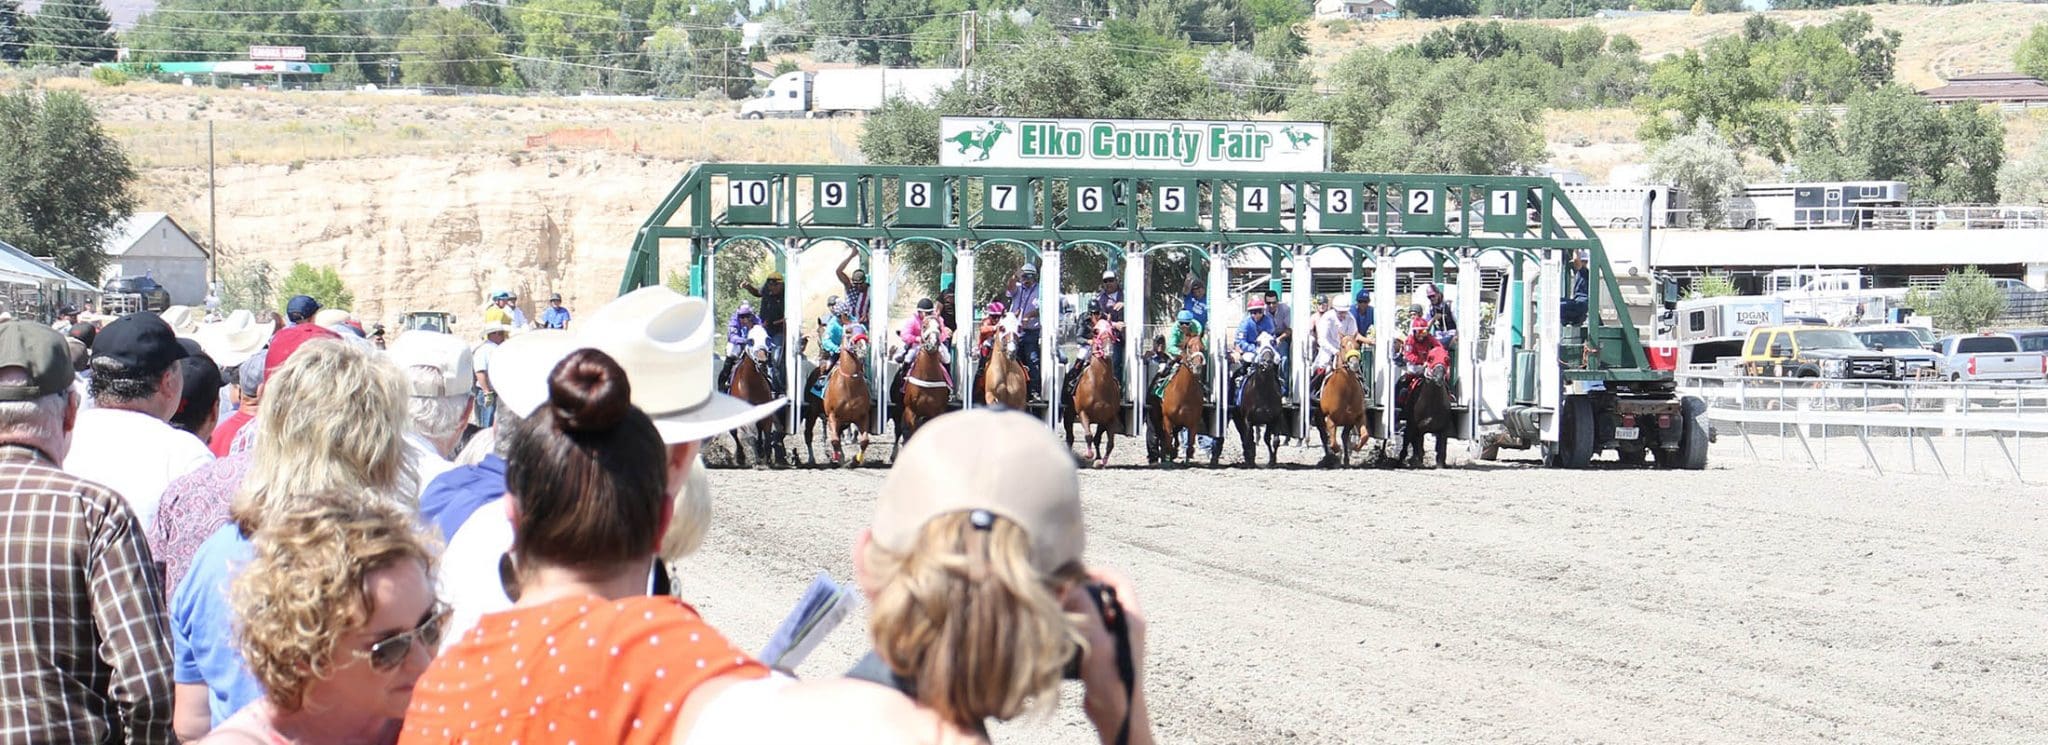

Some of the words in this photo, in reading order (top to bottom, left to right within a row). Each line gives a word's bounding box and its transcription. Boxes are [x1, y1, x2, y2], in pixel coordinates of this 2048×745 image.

[1020, 123, 1082, 157] Elko
[1091, 124, 1200, 164] County
[1209, 126, 1270, 160] Fair
[734, 181, 766, 206] 10
[825, 183, 843, 206] 9
[910, 183, 926, 207] 8
[995, 186, 1012, 209] 7
[1082, 187, 1098, 211] 6
[1164, 188, 1180, 211] 5
[1247, 188, 1264, 212] 4
[1332, 189, 1348, 213] 3
[1413, 190, 1430, 214] 2
[1499, 191, 1510, 214] 1
[1736, 311, 1769, 322] LOGAN
